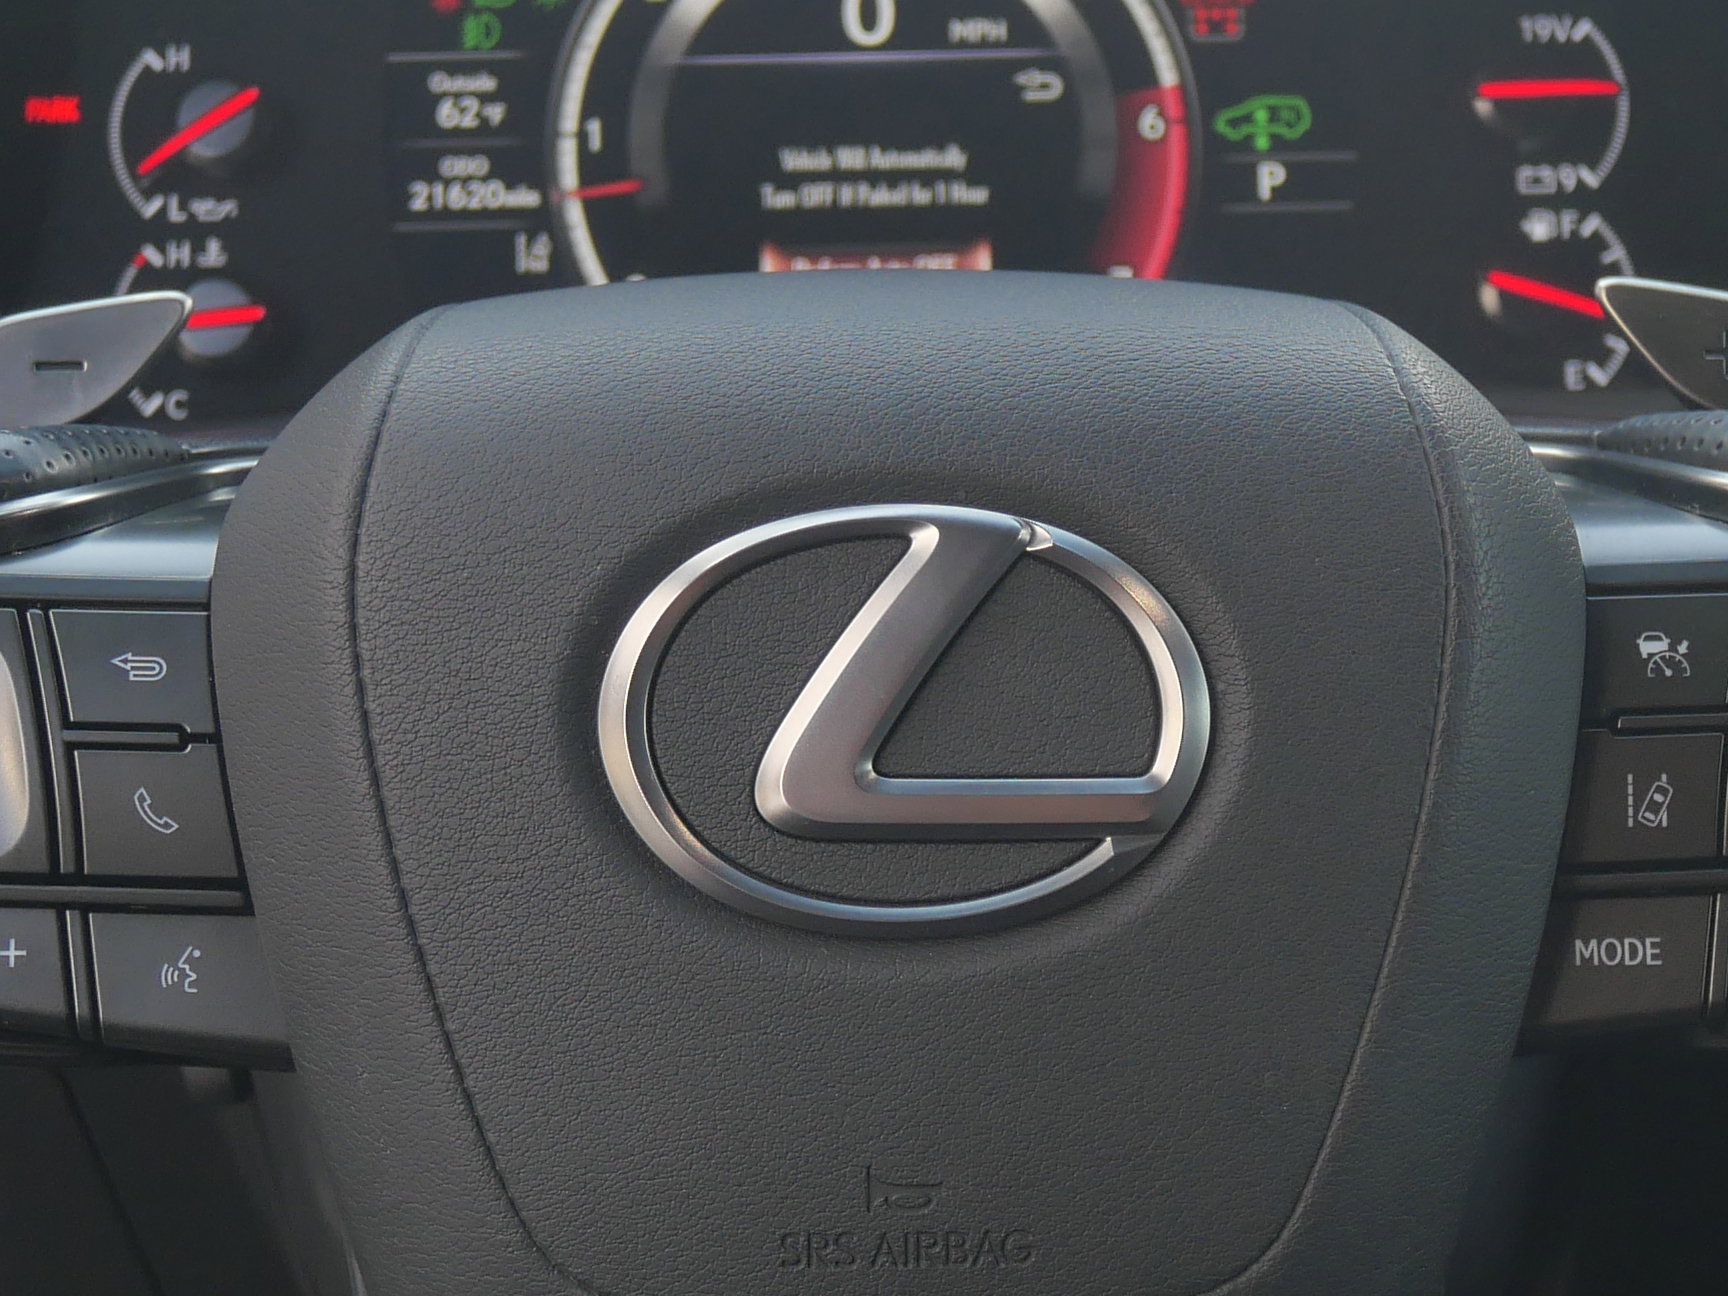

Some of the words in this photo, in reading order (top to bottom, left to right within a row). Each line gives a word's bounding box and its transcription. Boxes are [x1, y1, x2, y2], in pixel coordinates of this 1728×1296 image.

[583, 116, 603, 152] 1
[1137, 103, 1167, 141] 6
[1256, 161, 1287, 203] P
[1574, 936, 1663, 968] MODE
[779, 1230, 857, 1270] SRS
[871, 1227, 1037, 1269] AIRBAG
